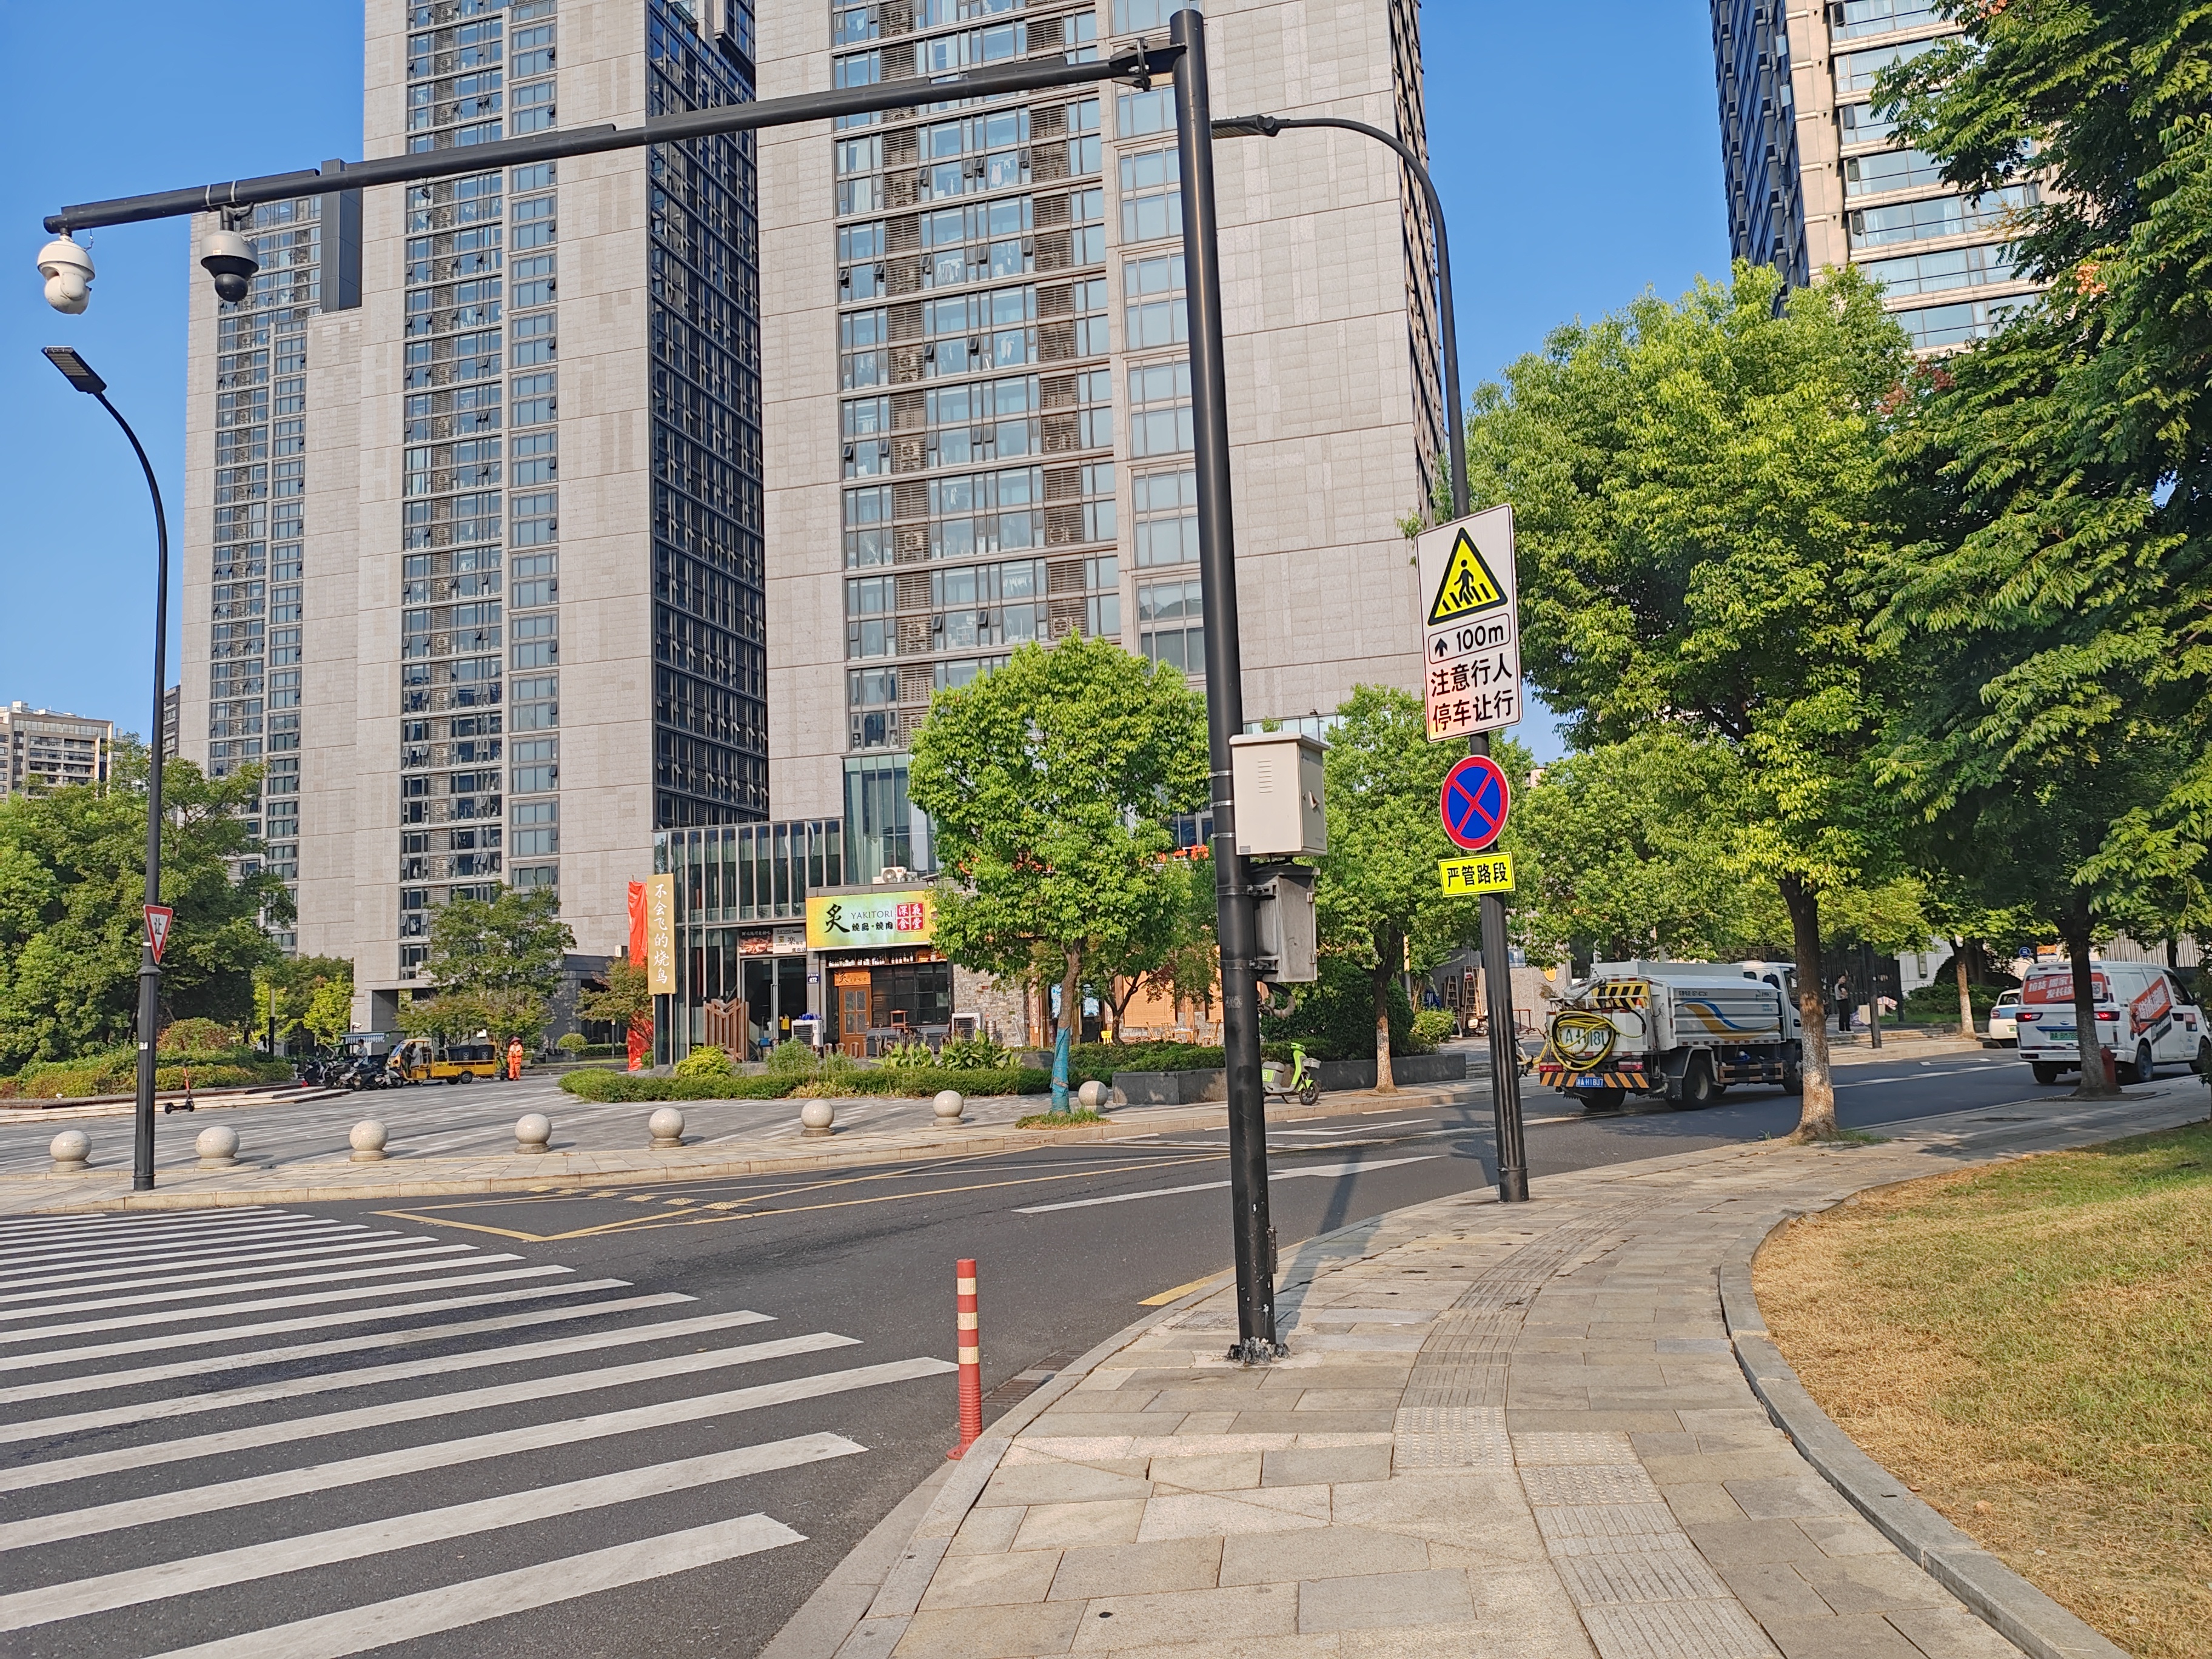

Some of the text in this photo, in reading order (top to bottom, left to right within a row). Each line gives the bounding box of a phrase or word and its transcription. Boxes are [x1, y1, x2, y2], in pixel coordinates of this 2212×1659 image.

[1455, 625, 1504, 652] 100m
[1430, 652, 1513, 697] 注意行人
[1432, 689, 1513, 733] 停车让行
[1446, 861, 1509, 888] 严管路段
[153, 917, 163, 935] 让
[823, 903, 851, 933] 炙
[851, 910, 893, 920] YAKITORI
[653, 883, 669, 984] 不会飞的烧鸟
